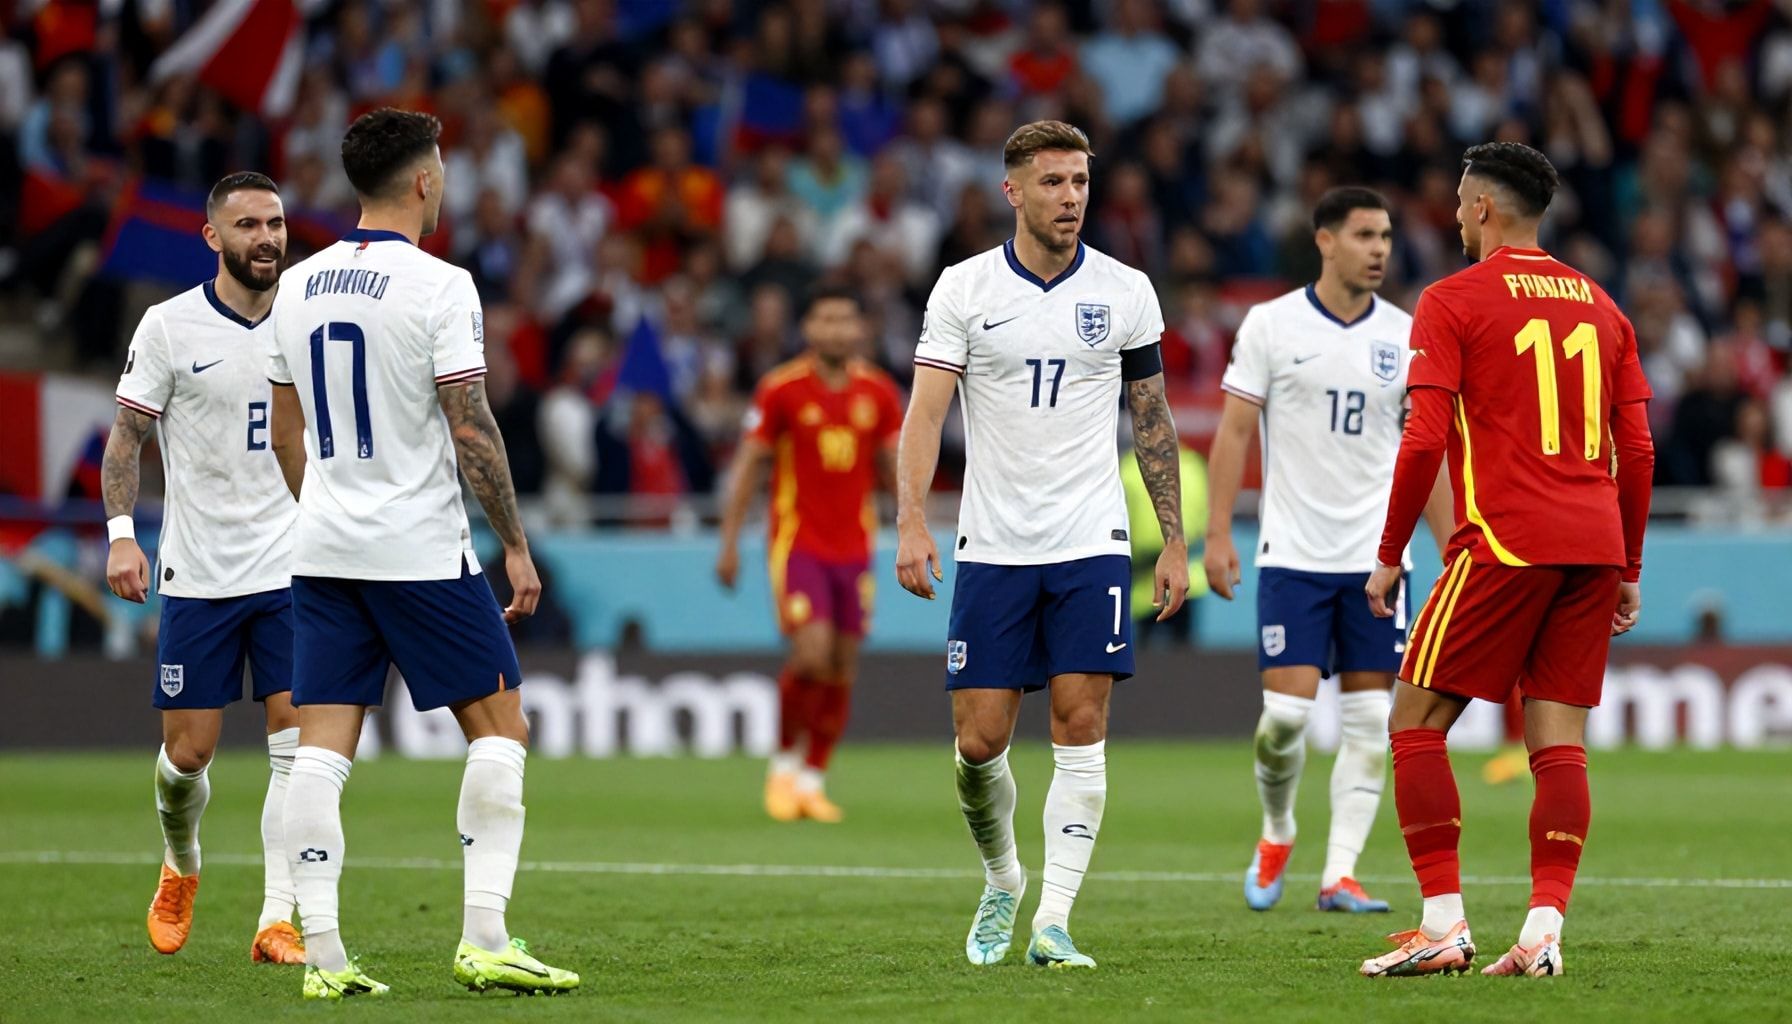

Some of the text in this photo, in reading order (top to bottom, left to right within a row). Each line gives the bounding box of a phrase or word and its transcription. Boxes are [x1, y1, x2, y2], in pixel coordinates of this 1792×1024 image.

[310, 321, 373, 459] 17
[1025, 358, 1066, 408] 17
[1514, 318, 1601, 461] 11
[247, 401, 267, 451] 2
[1108, 586, 1122, 635] 1
